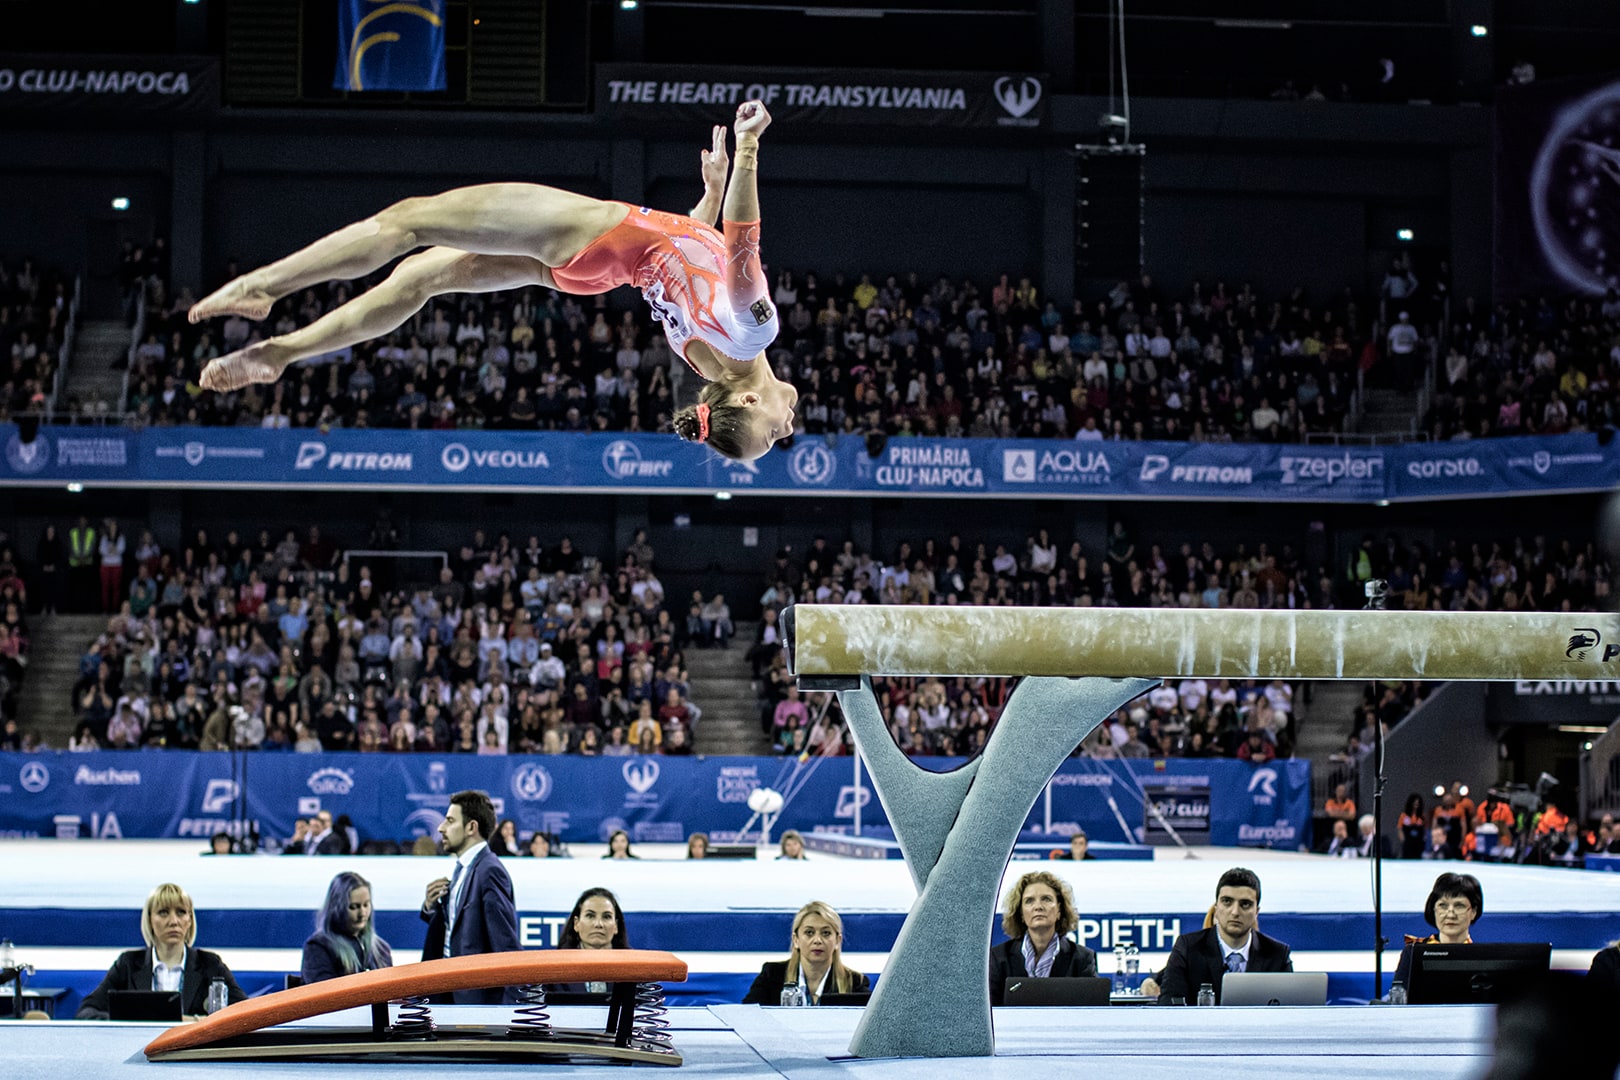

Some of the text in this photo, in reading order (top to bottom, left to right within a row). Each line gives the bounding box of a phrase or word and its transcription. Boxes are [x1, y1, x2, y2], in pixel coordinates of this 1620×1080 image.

[19, 69, 189, 94] CLUJ-NAPOCA
[608, 81, 966, 109] THE HEART OF TRANSYLVANIA
[328, 452, 413, 470] PETROM
[472, 450, 549, 468] VEOLIA
[889, 445, 971, 466] PRIMĂRIA
[1038, 451, 1111, 473] AQUA
[876, 467, 984, 487] CLUJ-NAPOCA
[1171, 465, 1253, 483] PETROM
[1602, 644, 1620, 662] P
[75, 765, 140, 785] Auchan
[1066, 919, 1180, 948] PIETH
